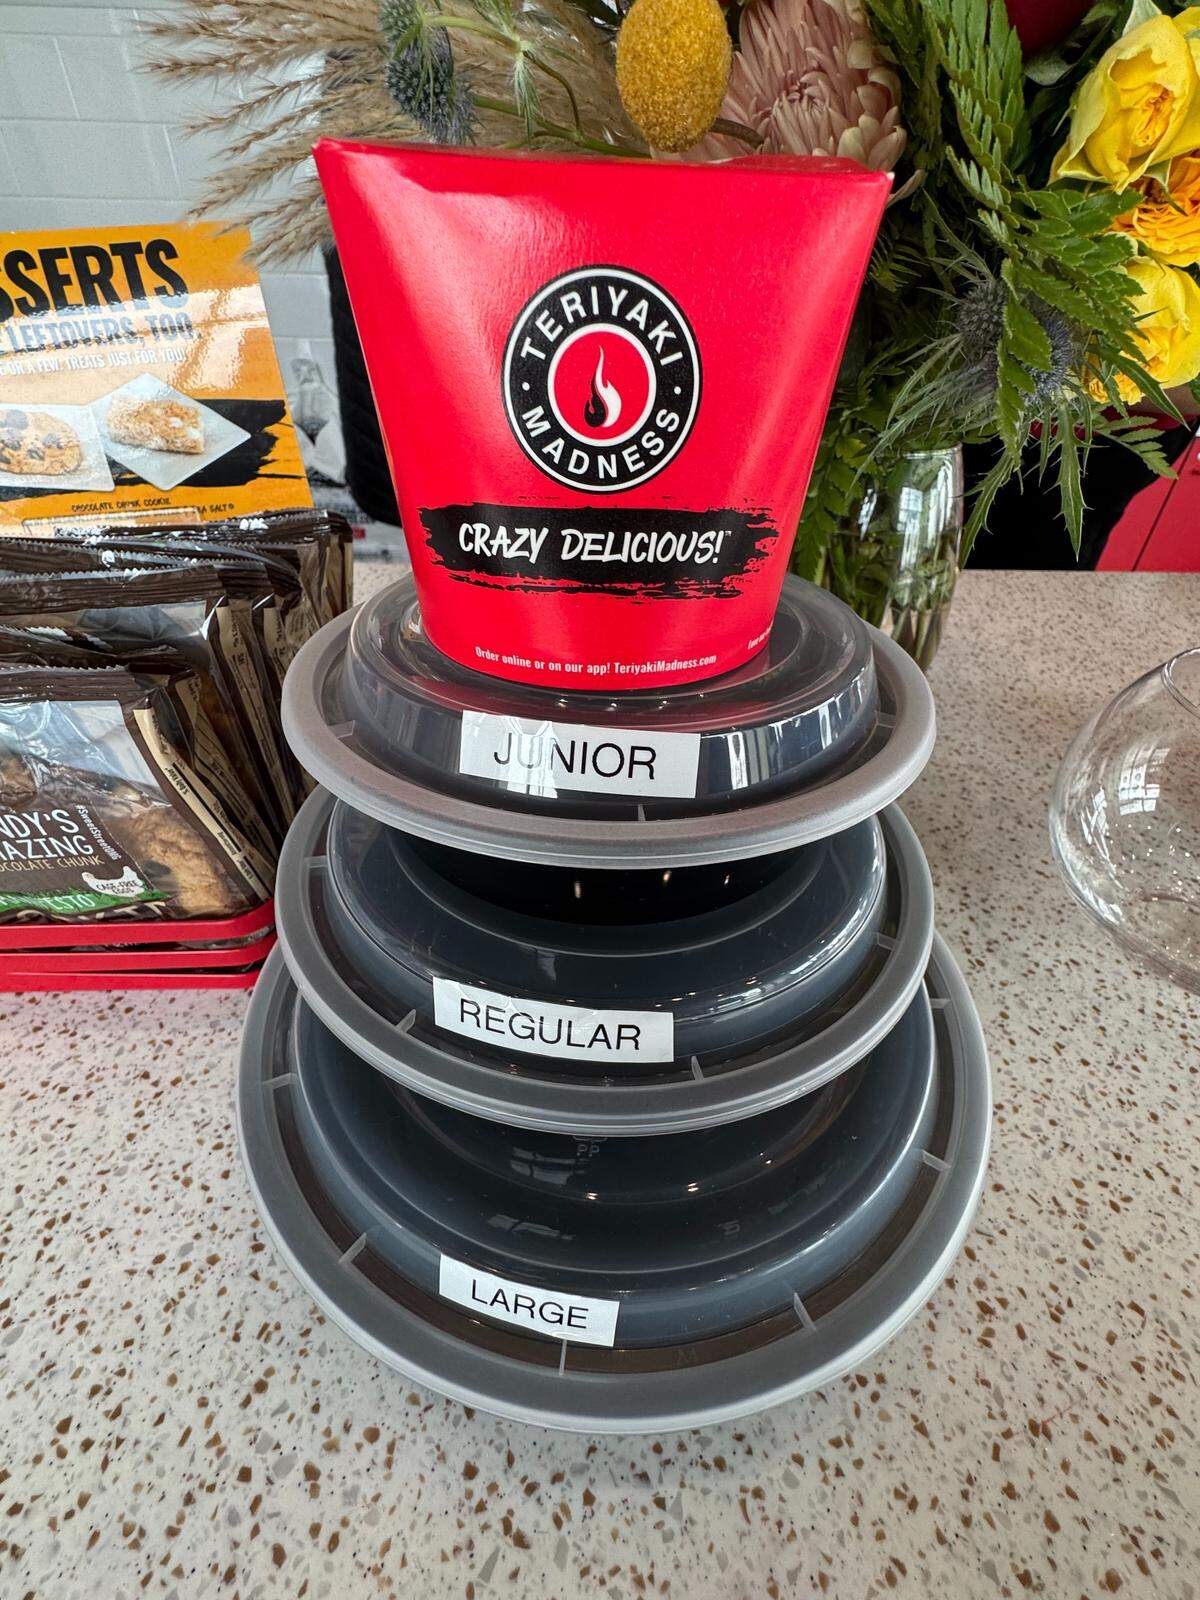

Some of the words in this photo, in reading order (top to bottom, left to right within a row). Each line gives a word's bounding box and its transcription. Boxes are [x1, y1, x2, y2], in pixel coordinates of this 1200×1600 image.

[520, 285, 683, 367] TERIYAKI
[522, 405, 680, 479] MADNESS
[458, 522, 549, 564] CRAZY
[475, 646, 499, 661] Order
[502, 654, 532, 668] online
[534, 660, 545, 669] or
[548, 662, 562, 671] on
[565, 663, 583, 673] our
[586, 662, 611, 675] app!
[614, 655, 717, 676] TeriyakiMadness.com
[494, 733, 657, 780] JUNIOR
[57, 855, 105, 868] CHUNK
[460, 998, 641, 1050] REGULAR
[471, 1279, 589, 1329] LARGE
